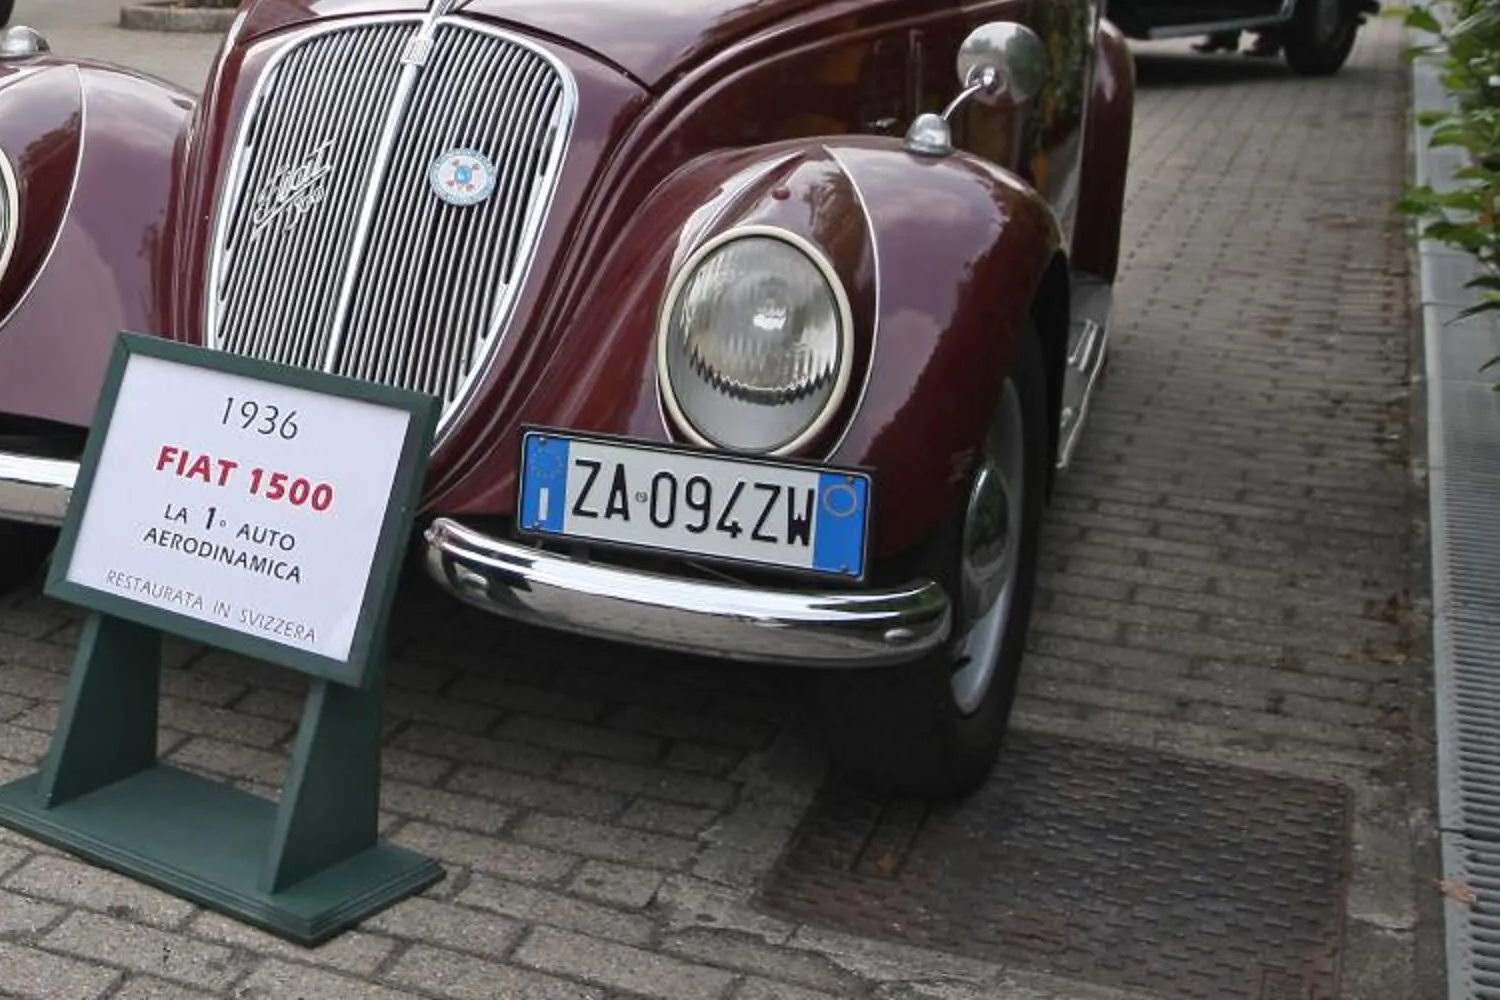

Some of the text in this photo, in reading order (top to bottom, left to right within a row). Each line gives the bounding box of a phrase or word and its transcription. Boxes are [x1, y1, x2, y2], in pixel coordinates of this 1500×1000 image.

[221, 396, 299, 441] 1936
[155, 445, 333, 512] FIAT 1500
[143, 527, 301, 584] AERODINAMICA
[163, 503, 188, 525] LA
[235, 523, 296, 552] AUTO
[106, 569, 316, 644] RESTAURATA IN SVIZZERA
